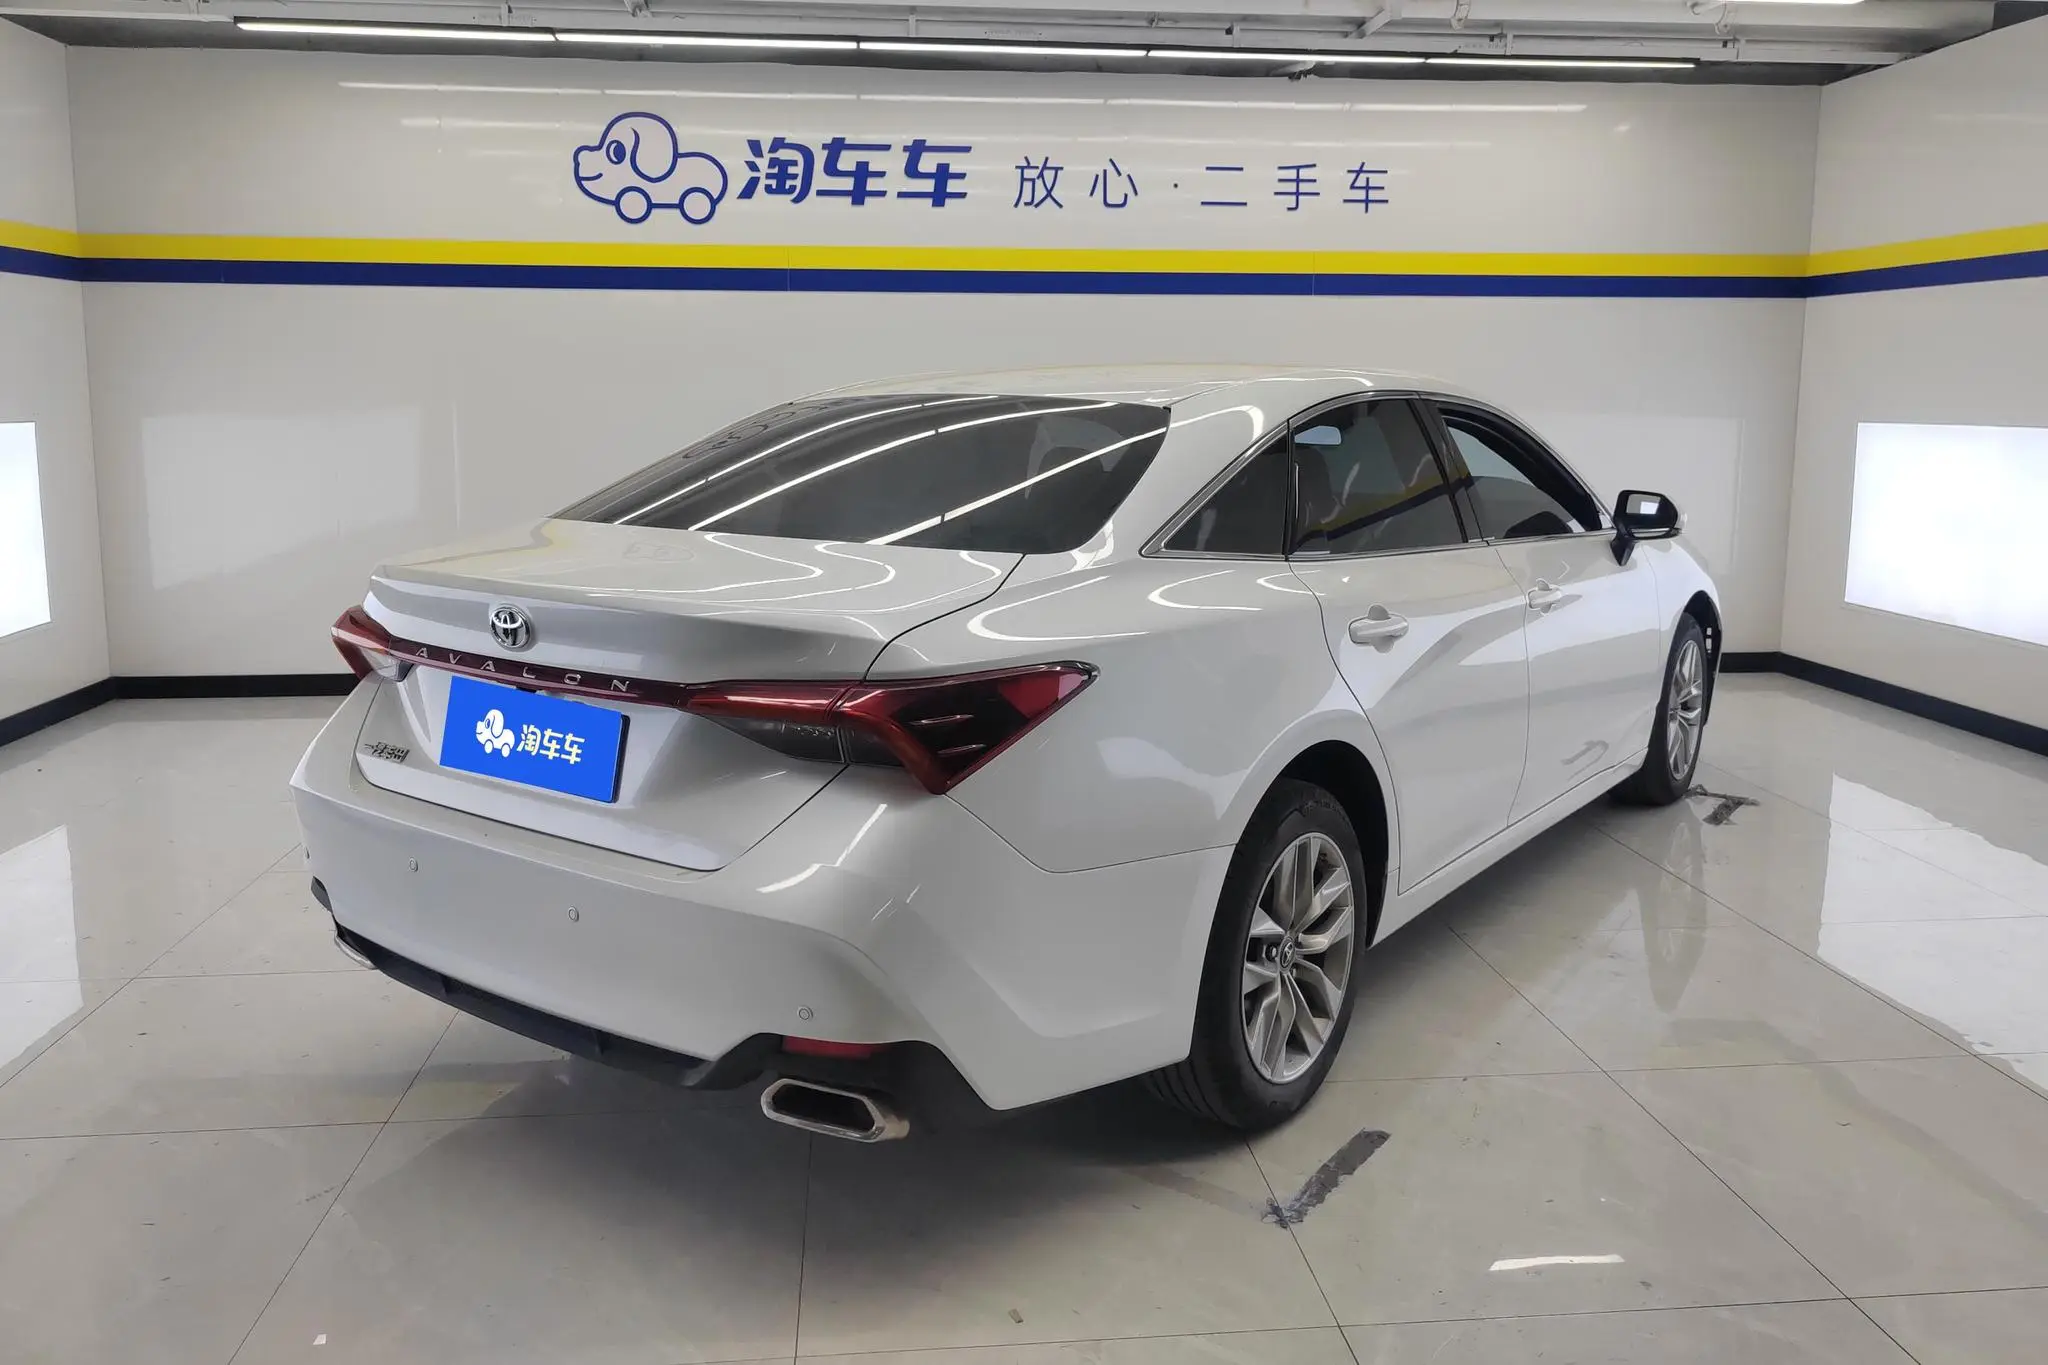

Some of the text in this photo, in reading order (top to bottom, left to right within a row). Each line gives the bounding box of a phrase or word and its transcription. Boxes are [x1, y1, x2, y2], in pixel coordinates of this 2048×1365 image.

[737, 137, 972, 207] 淘车车
[415, 647, 630, 692] AVALON
